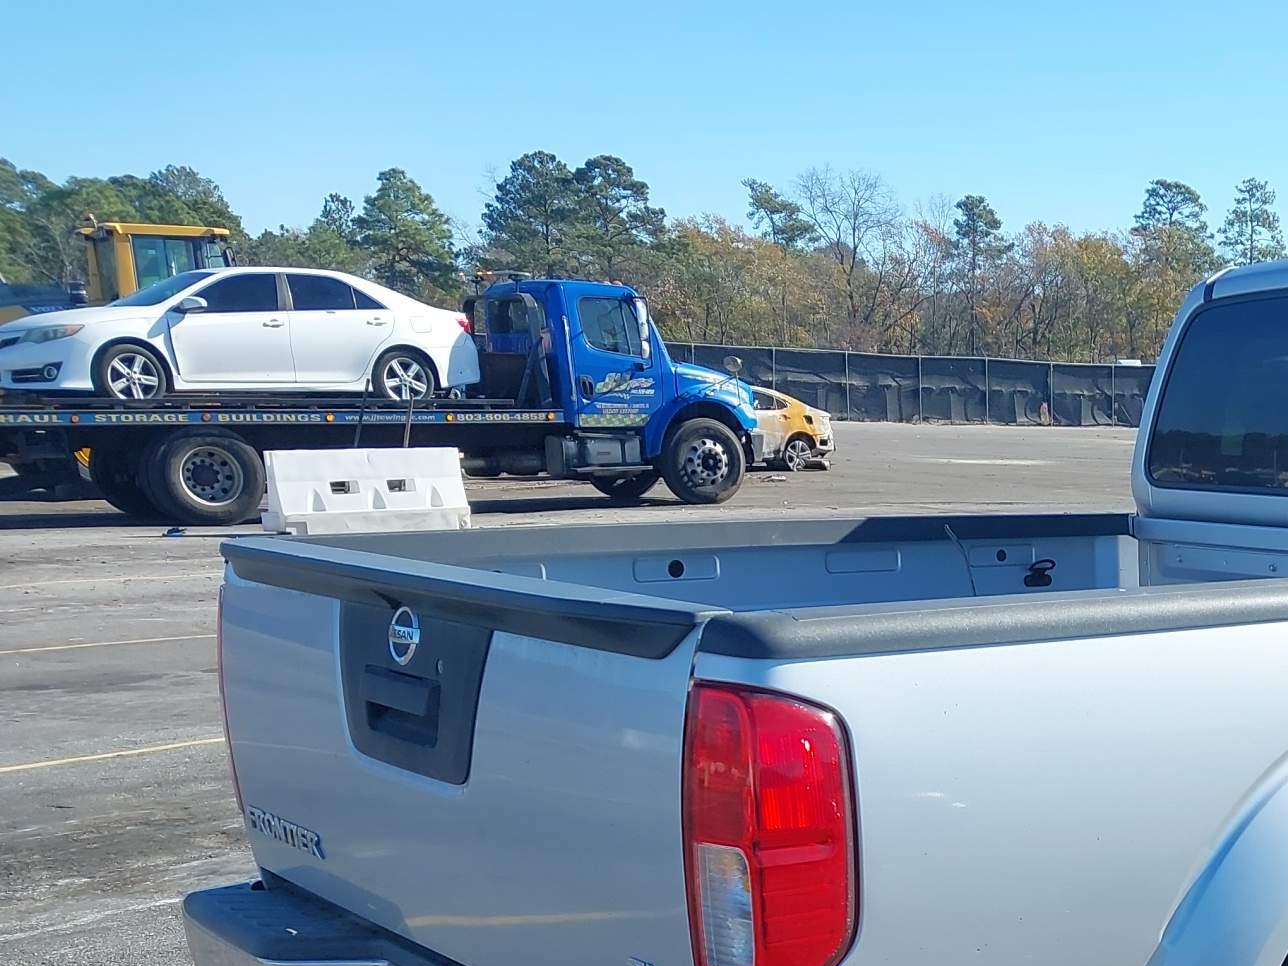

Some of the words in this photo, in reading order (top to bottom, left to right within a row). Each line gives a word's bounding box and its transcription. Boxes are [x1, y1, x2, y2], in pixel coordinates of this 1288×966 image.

[0, 413, 64, 423] HAUL
[94, 413, 189, 422] STORAGE
[218, 413, 321, 422] BUILDINGS
[456, 413, 546, 421] 803-506-4858
[247, 804, 325, 860] FRONTIER
